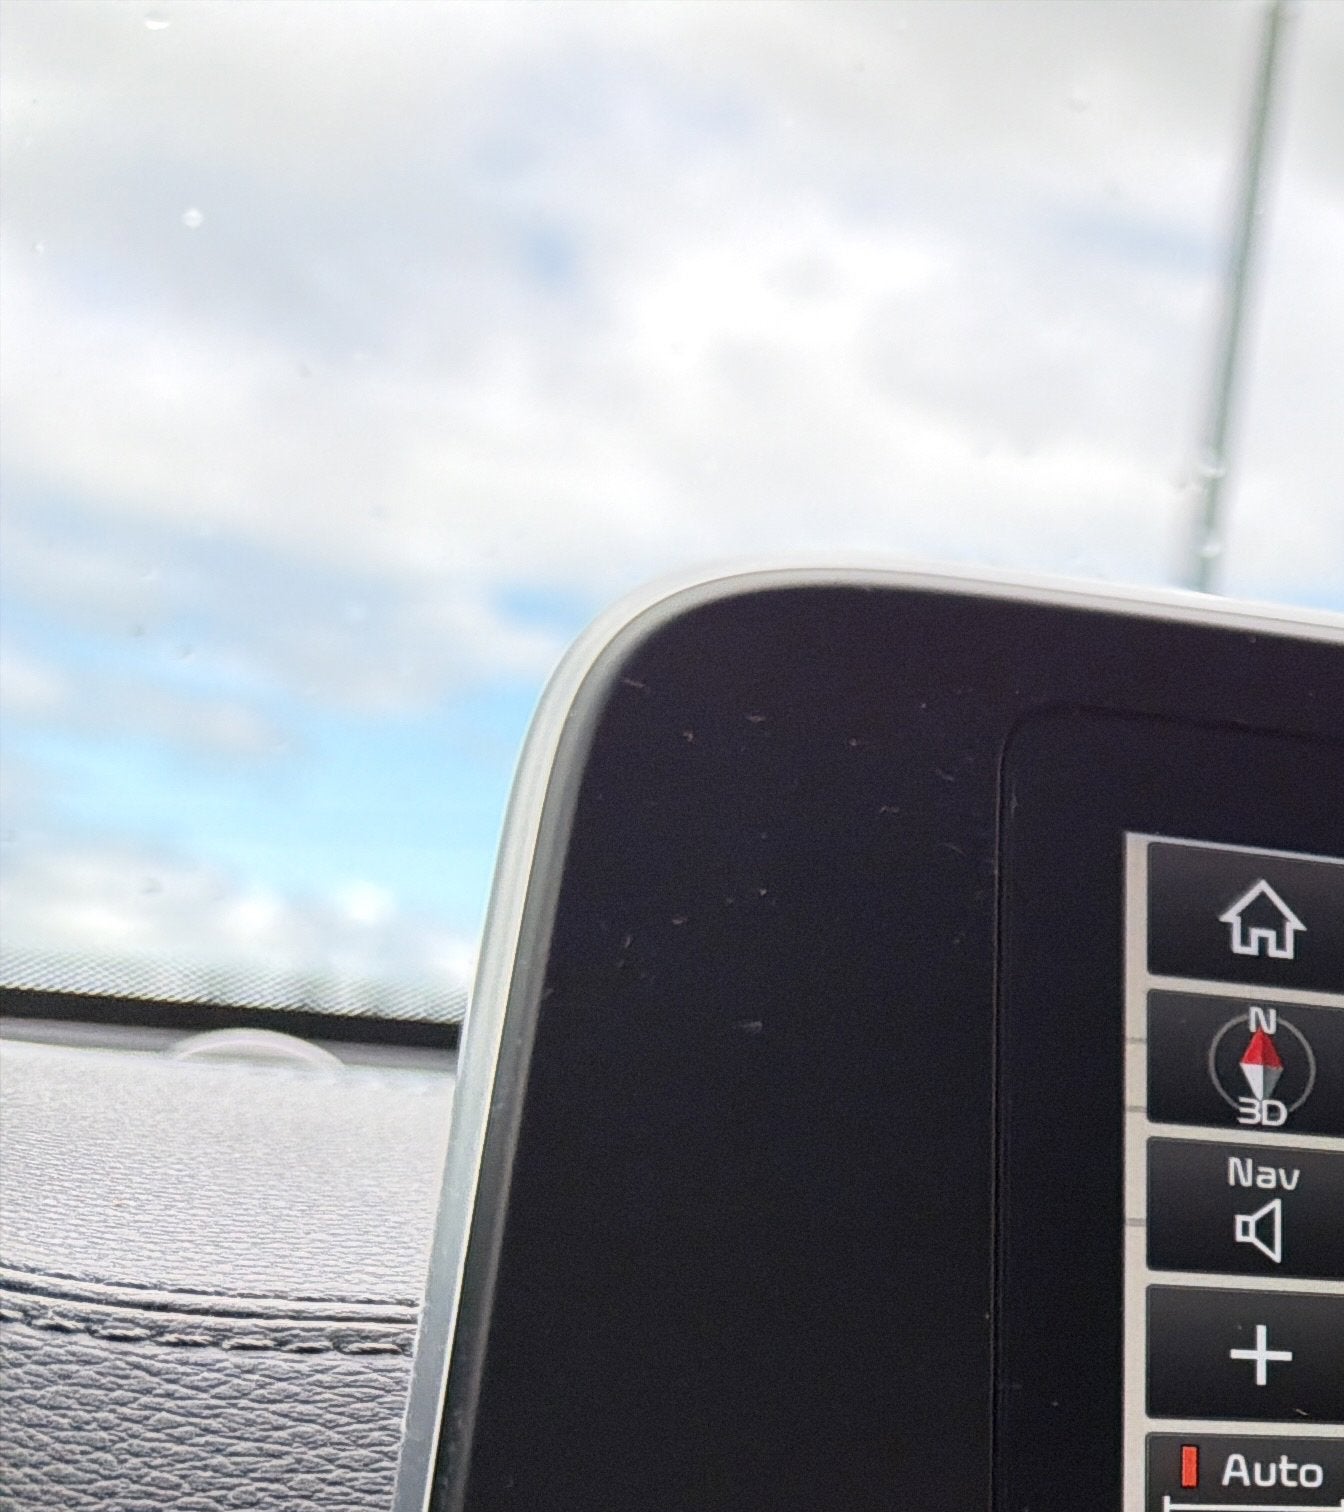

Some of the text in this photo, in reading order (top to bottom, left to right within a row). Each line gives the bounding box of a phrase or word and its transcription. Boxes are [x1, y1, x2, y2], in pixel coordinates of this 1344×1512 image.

[1249, 1006, 1277, 1036] N
[1236, 1096, 1289, 1128] 3D
[1227, 1156, 1301, 1191] Nav
[1221, 1453, 1324, 1489] Auto
